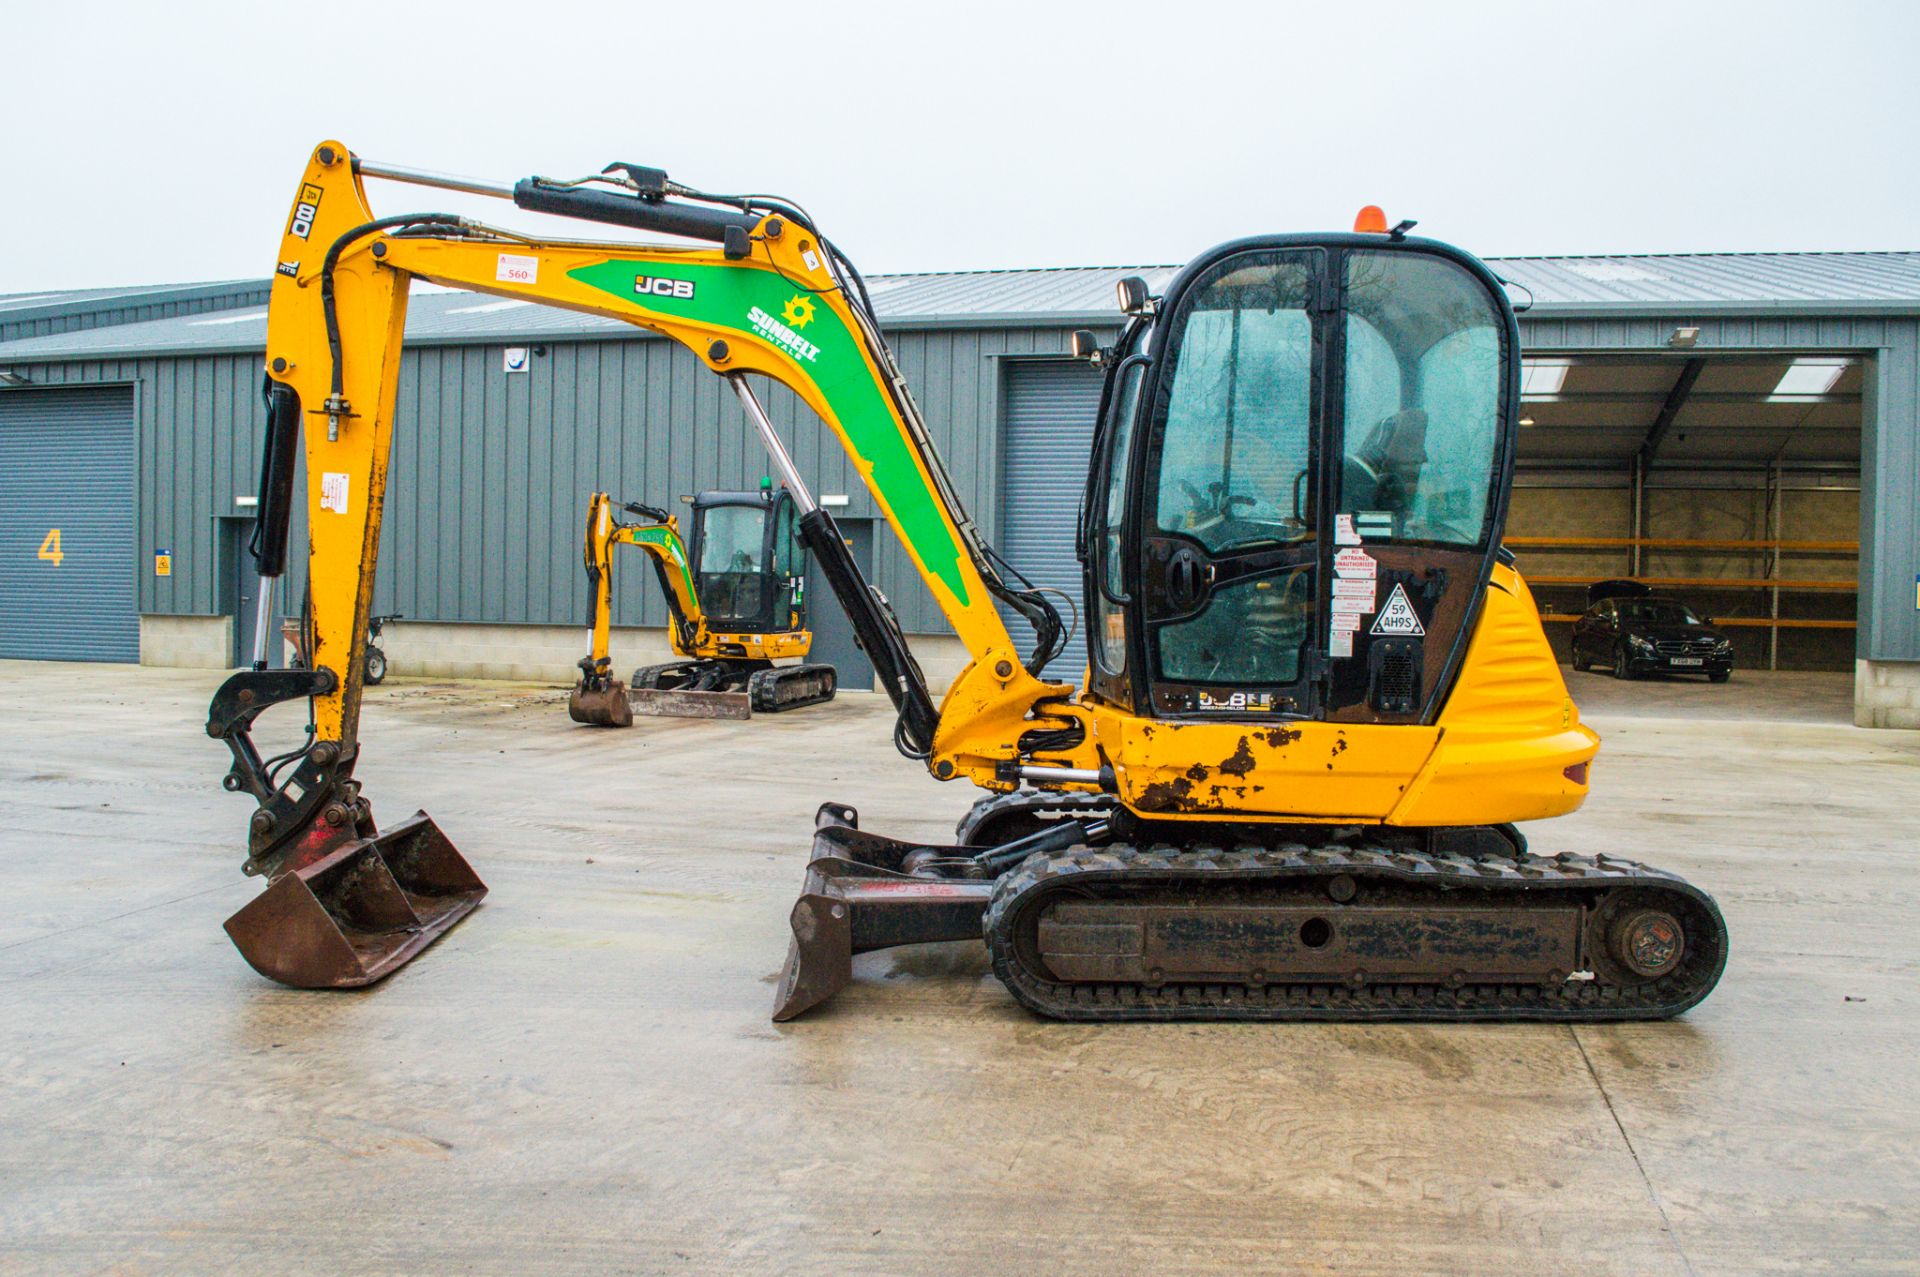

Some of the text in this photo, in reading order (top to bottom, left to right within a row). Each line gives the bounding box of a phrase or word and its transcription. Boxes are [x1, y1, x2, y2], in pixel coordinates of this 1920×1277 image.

[508, 269, 528, 280] 560
[635, 275, 694, 299] JCB
[747, 306, 821, 361] SUNBELT
[37, 528, 64, 567] 4
[1392, 604, 1406, 615] 59
[1384, 616, 1412, 628] AH9S
